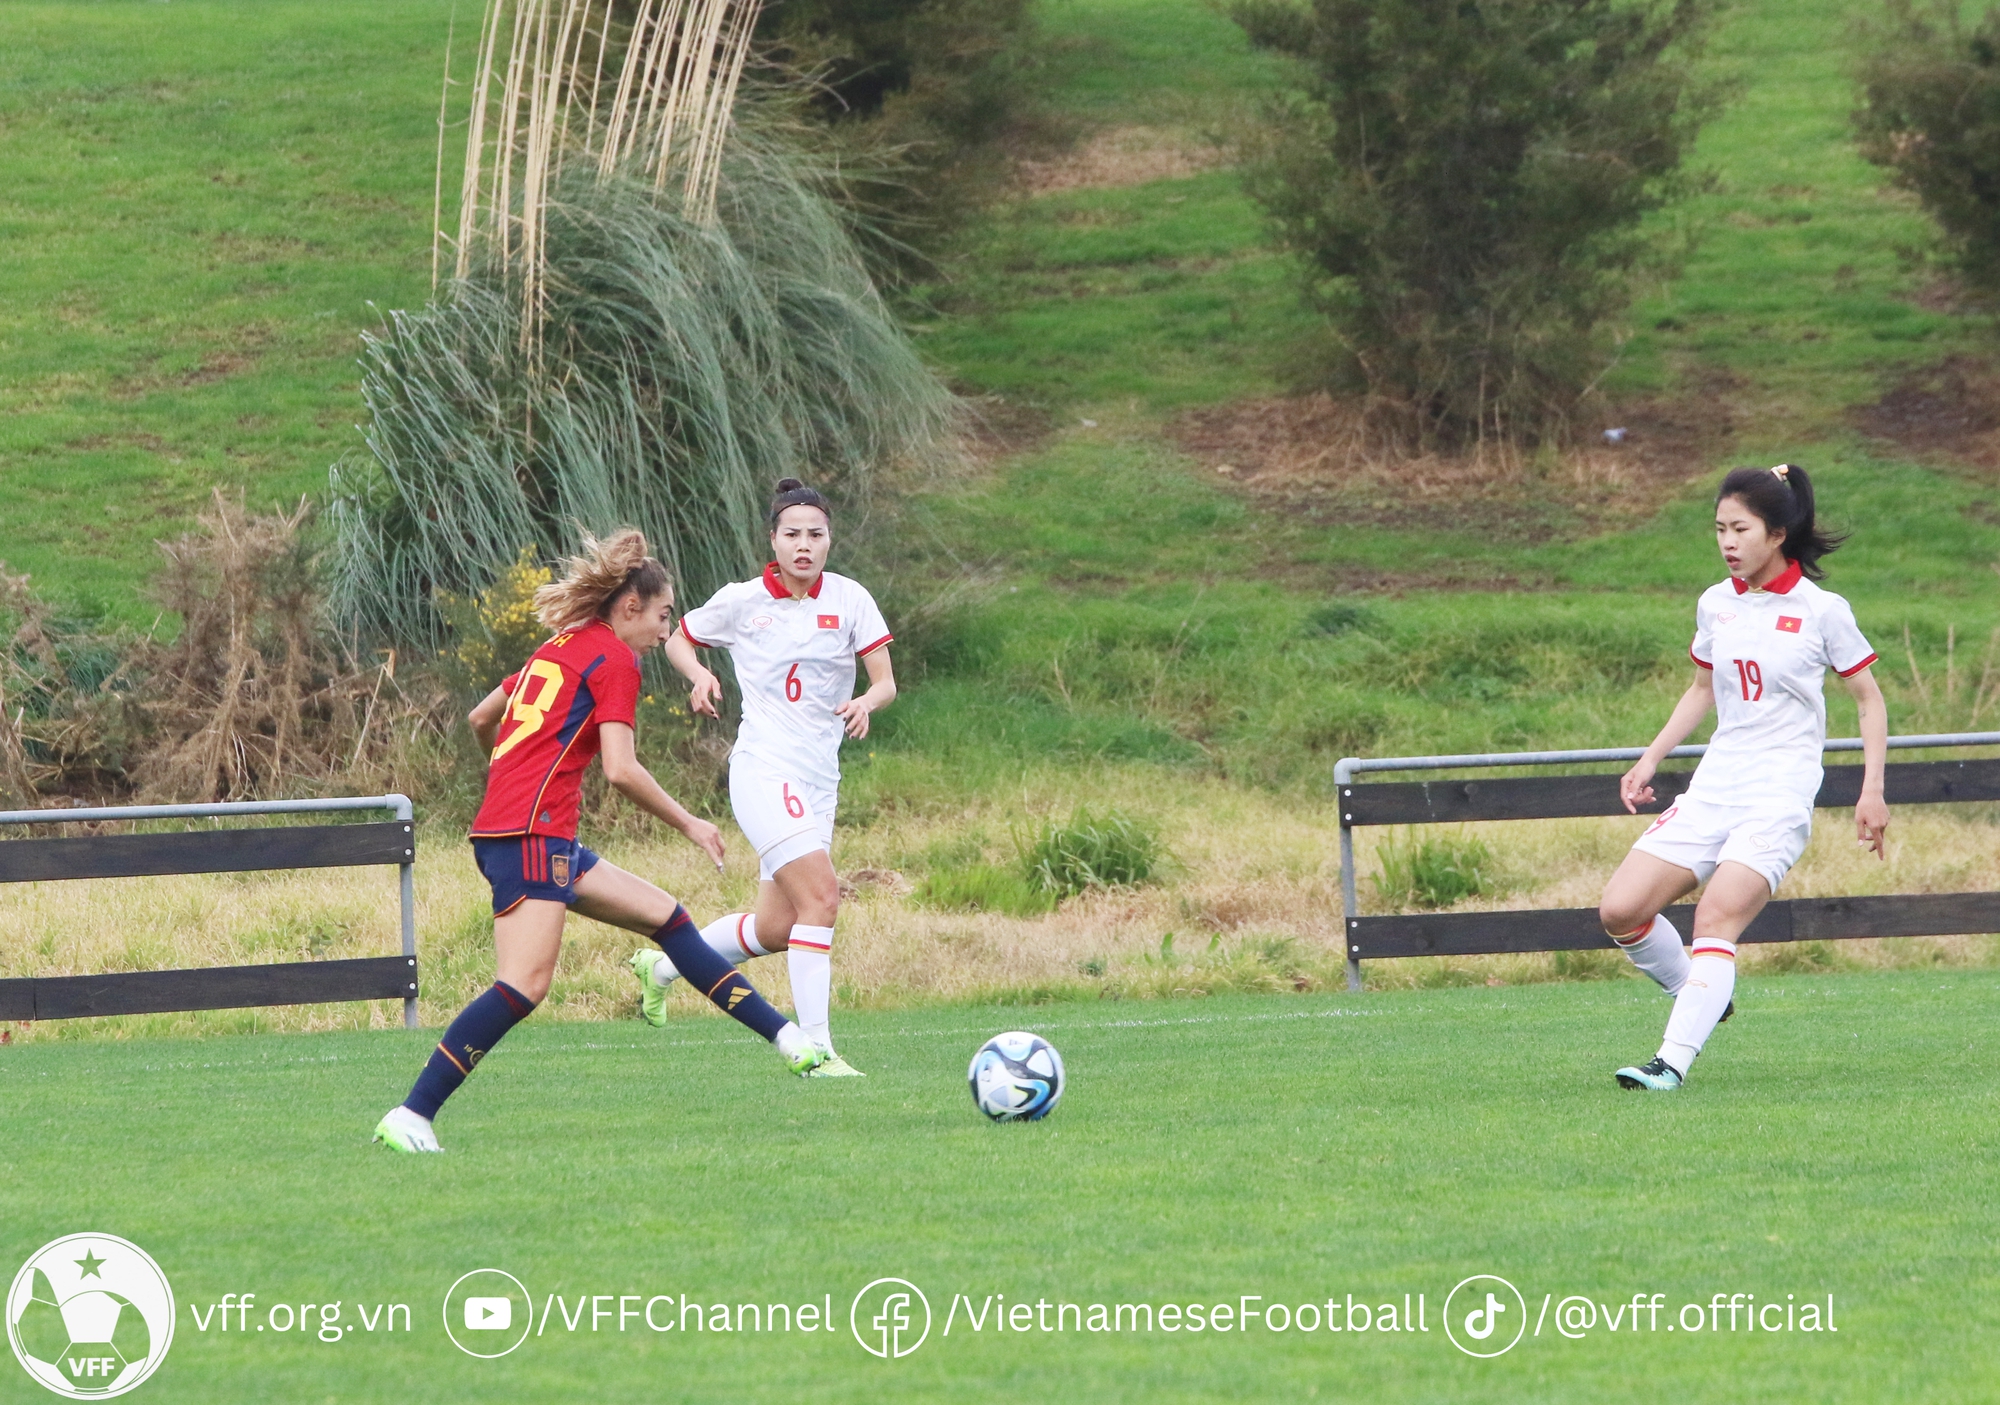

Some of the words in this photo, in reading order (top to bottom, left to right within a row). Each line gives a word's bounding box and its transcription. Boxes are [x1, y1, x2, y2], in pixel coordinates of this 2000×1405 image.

[785, 662, 802, 702] 6
[1733, 659, 1763, 702] 19
[783, 782, 805, 819] 6
